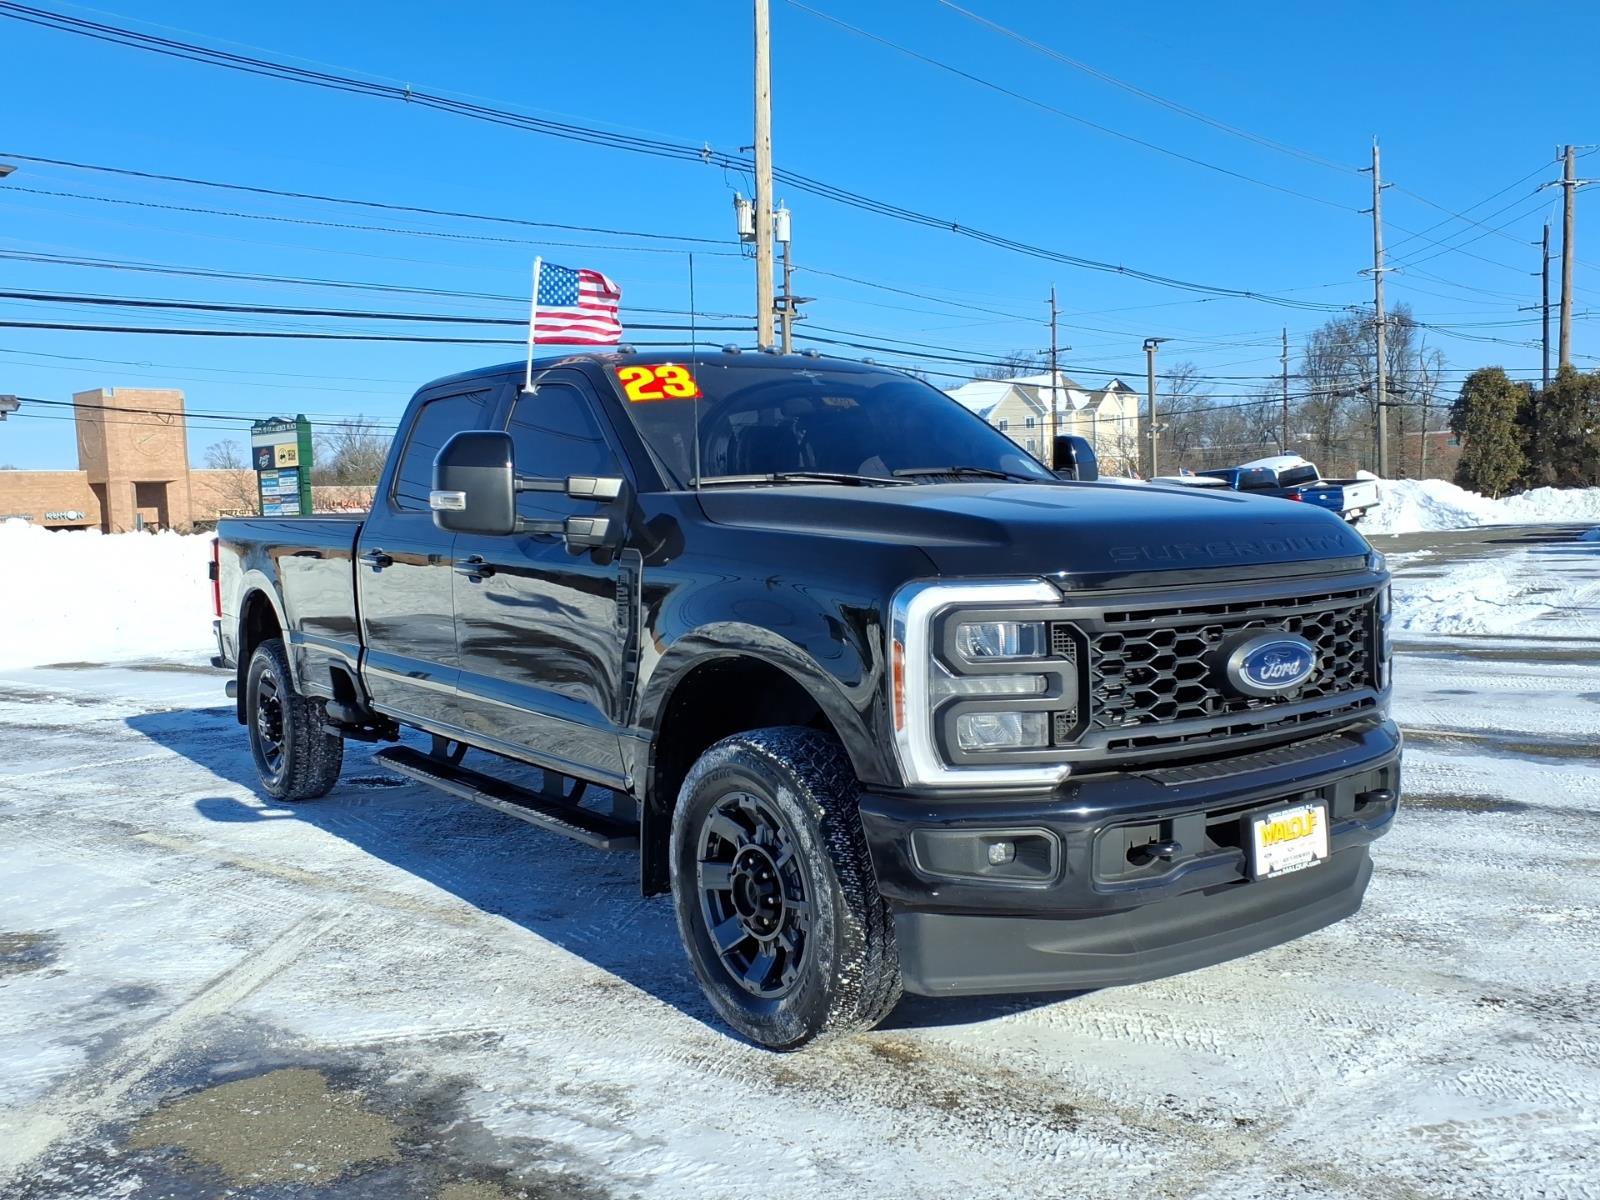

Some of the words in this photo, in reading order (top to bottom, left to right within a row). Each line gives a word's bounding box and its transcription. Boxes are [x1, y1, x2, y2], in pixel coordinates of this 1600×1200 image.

[618, 365, 698, 403] 23
[1107, 541, 1259, 564] SUPER
[1262, 534, 1345, 553] DUTY
[1259, 651, 1301, 680] Ford
[1261, 811, 1318, 848] MALOUF
